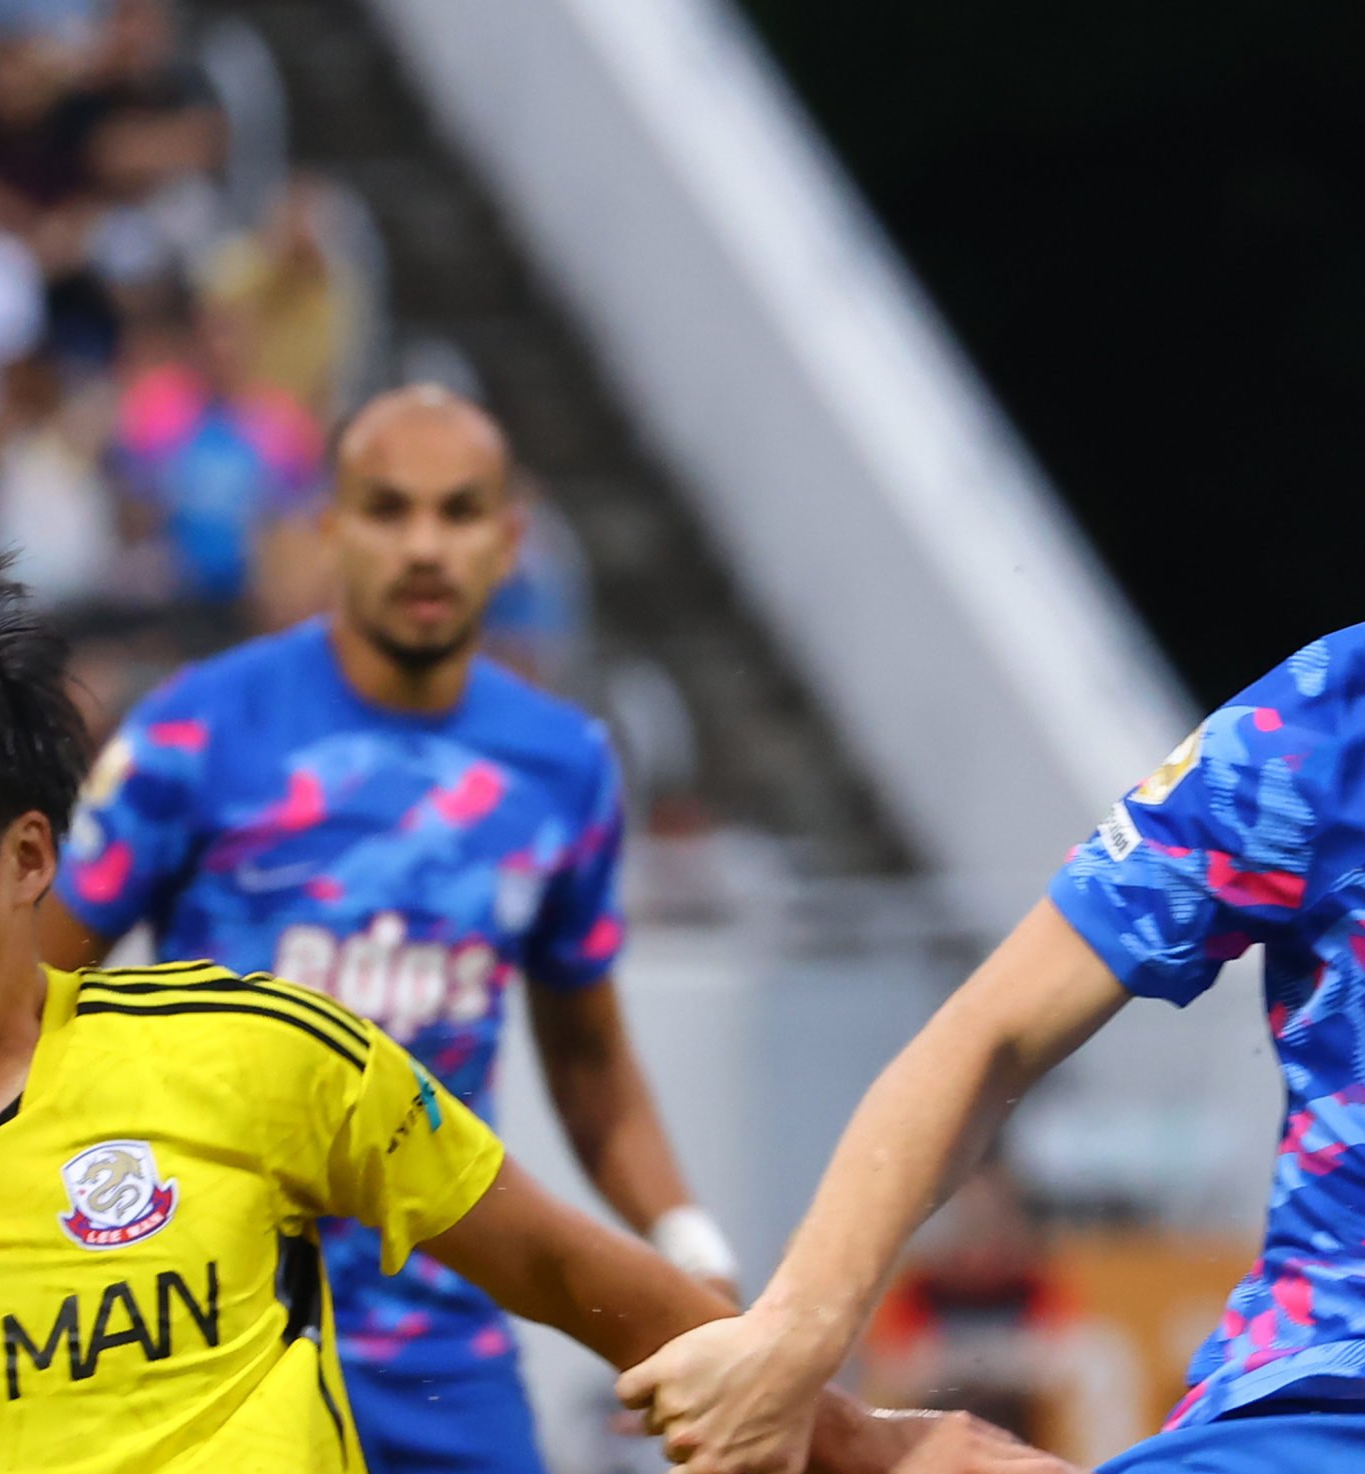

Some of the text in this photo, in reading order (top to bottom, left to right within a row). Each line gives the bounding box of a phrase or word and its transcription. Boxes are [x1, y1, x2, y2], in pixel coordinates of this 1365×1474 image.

[85, 1211, 165, 1243] LEE MAN
[1, 1260, 220, 1402] MAN
